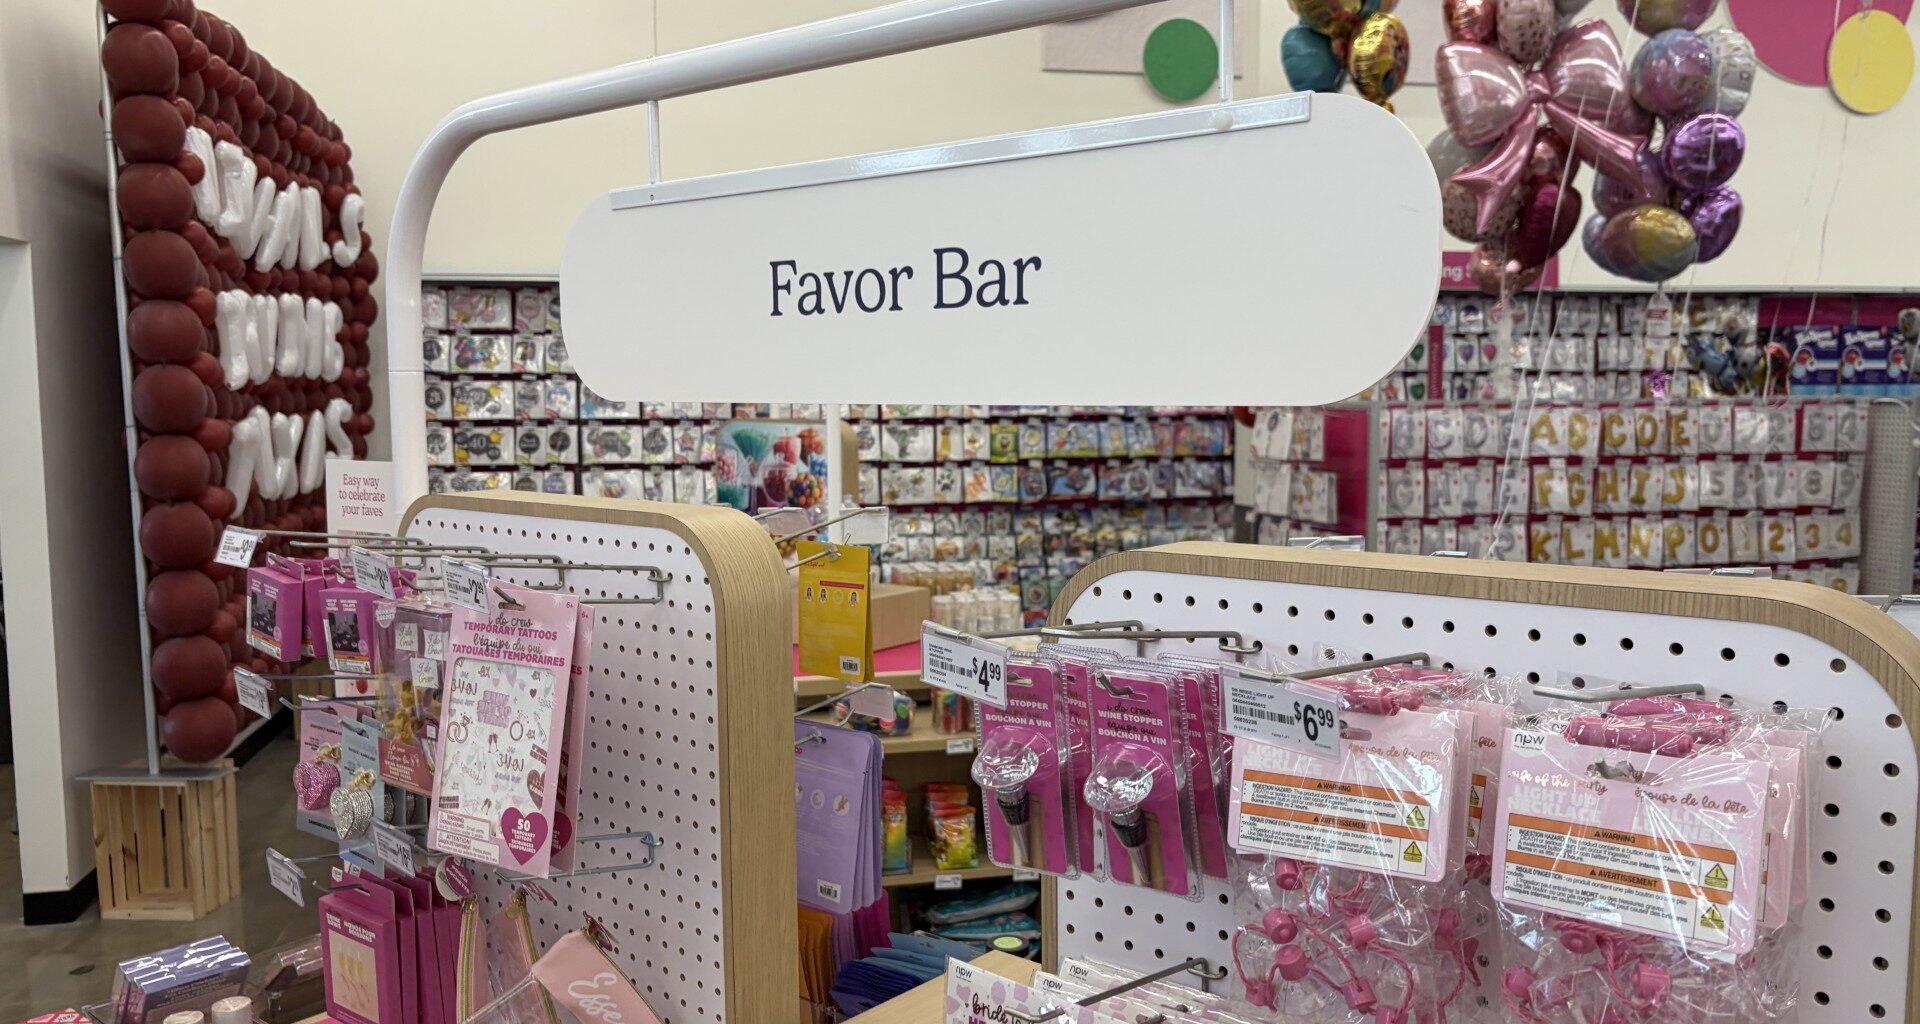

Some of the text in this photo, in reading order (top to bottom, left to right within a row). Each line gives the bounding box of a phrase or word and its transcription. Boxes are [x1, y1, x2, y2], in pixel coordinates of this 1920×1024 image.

[769, 247, 1042, 316] Favor Bar
[1532, 411, 1690, 448] A B C D E
[343, 473, 379, 490] Easy way
[1536, 473, 1555, 506] F
[1567, 474, 1585, 508] G
[1599, 470, 1619, 502] H
[339, 489, 386, 503] to celebrate
[341, 503, 383, 517] your faves
[1532, 528, 1550, 561] K
[1563, 528, 1585, 560] L
[1596, 528, 1620, 559] M
[1769, 521, 1785, 552] 2
[495, 612, 509, 625] do
[511, 616, 533, 628] crew
[463, 620, 557, 641] TEMPORARY TATTOOS
[451, 642, 565, 667] TATOUAGES TEMPORAIRES
[1009, 698, 1048, 709] STOPPER
[1114, 701, 1127, 712] do
[985, 714, 1027, 724] BOUCHON
[1035, 719, 1051, 727] VIN
[1097, 710, 1163, 726] WINE STOPPER
[1098, 728, 1141, 740] BOUCHON
[1150, 736, 1166, 745] VIN
[1514, 733, 1544, 746] npw
[1535, 772, 1549, 787] of
[1552, 772, 1571, 788] the
[1514, 785, 1597, 807] LIGHT UP
[1681, 793, 1698, 807] de
[1702, 795, 1720, 809] la
[1723, 799, 1749, 814] fête
[1508, 797, 1600, 824] NECKLACE
[516, 818, 531, 831] 50
[511, 829, 535, 837] TEMPORARY
[514, 834, 532, 842] TATTOOS
[1602, 831, 1635, 843] WARNING
[508, 843, 535, 853] TEMPORAIRES
[510, 839, 533, 847] TATOUAGES
[1597, 870, 1657, 887] AVERTISSEMENT
[955, 965, 973, 979] npw
[1069, 964, 1089, 977] npw
[1043, 978, 1063, 991] npw
[972, 993, 1008, 1024] bride
